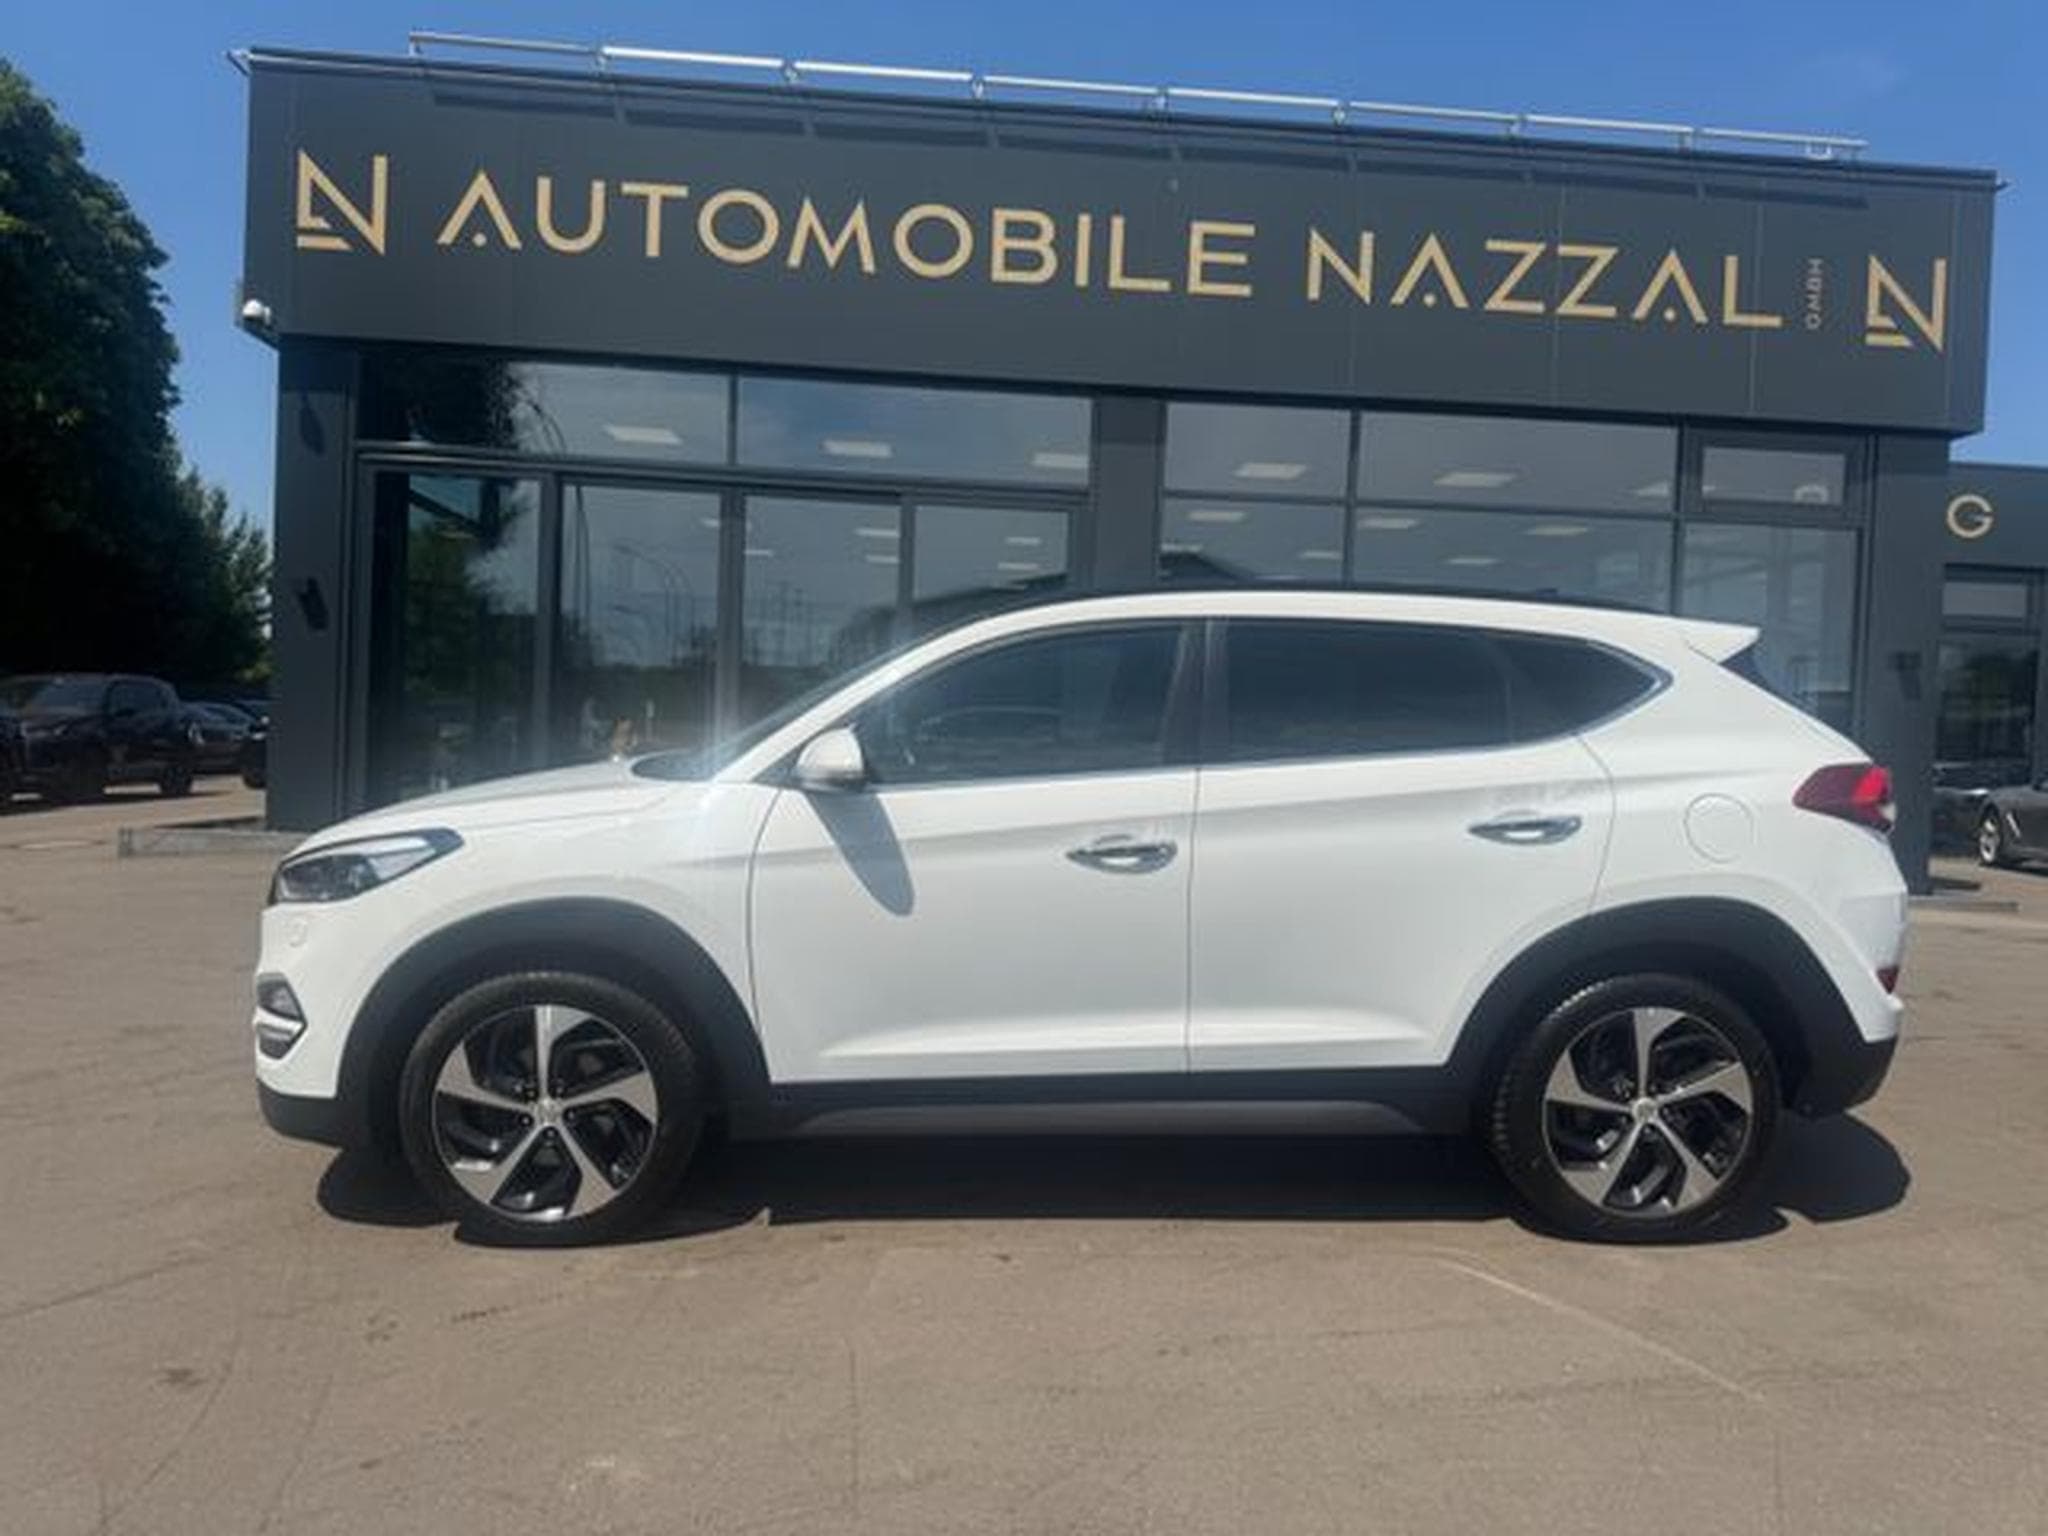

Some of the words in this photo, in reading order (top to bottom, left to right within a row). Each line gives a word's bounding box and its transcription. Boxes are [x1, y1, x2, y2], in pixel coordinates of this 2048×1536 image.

[436, 168, 1256, 298] AUTOMOBILE
[1307, 227, 1783, 328] NAZZAL
[1946, 494, 1994, 538] G
